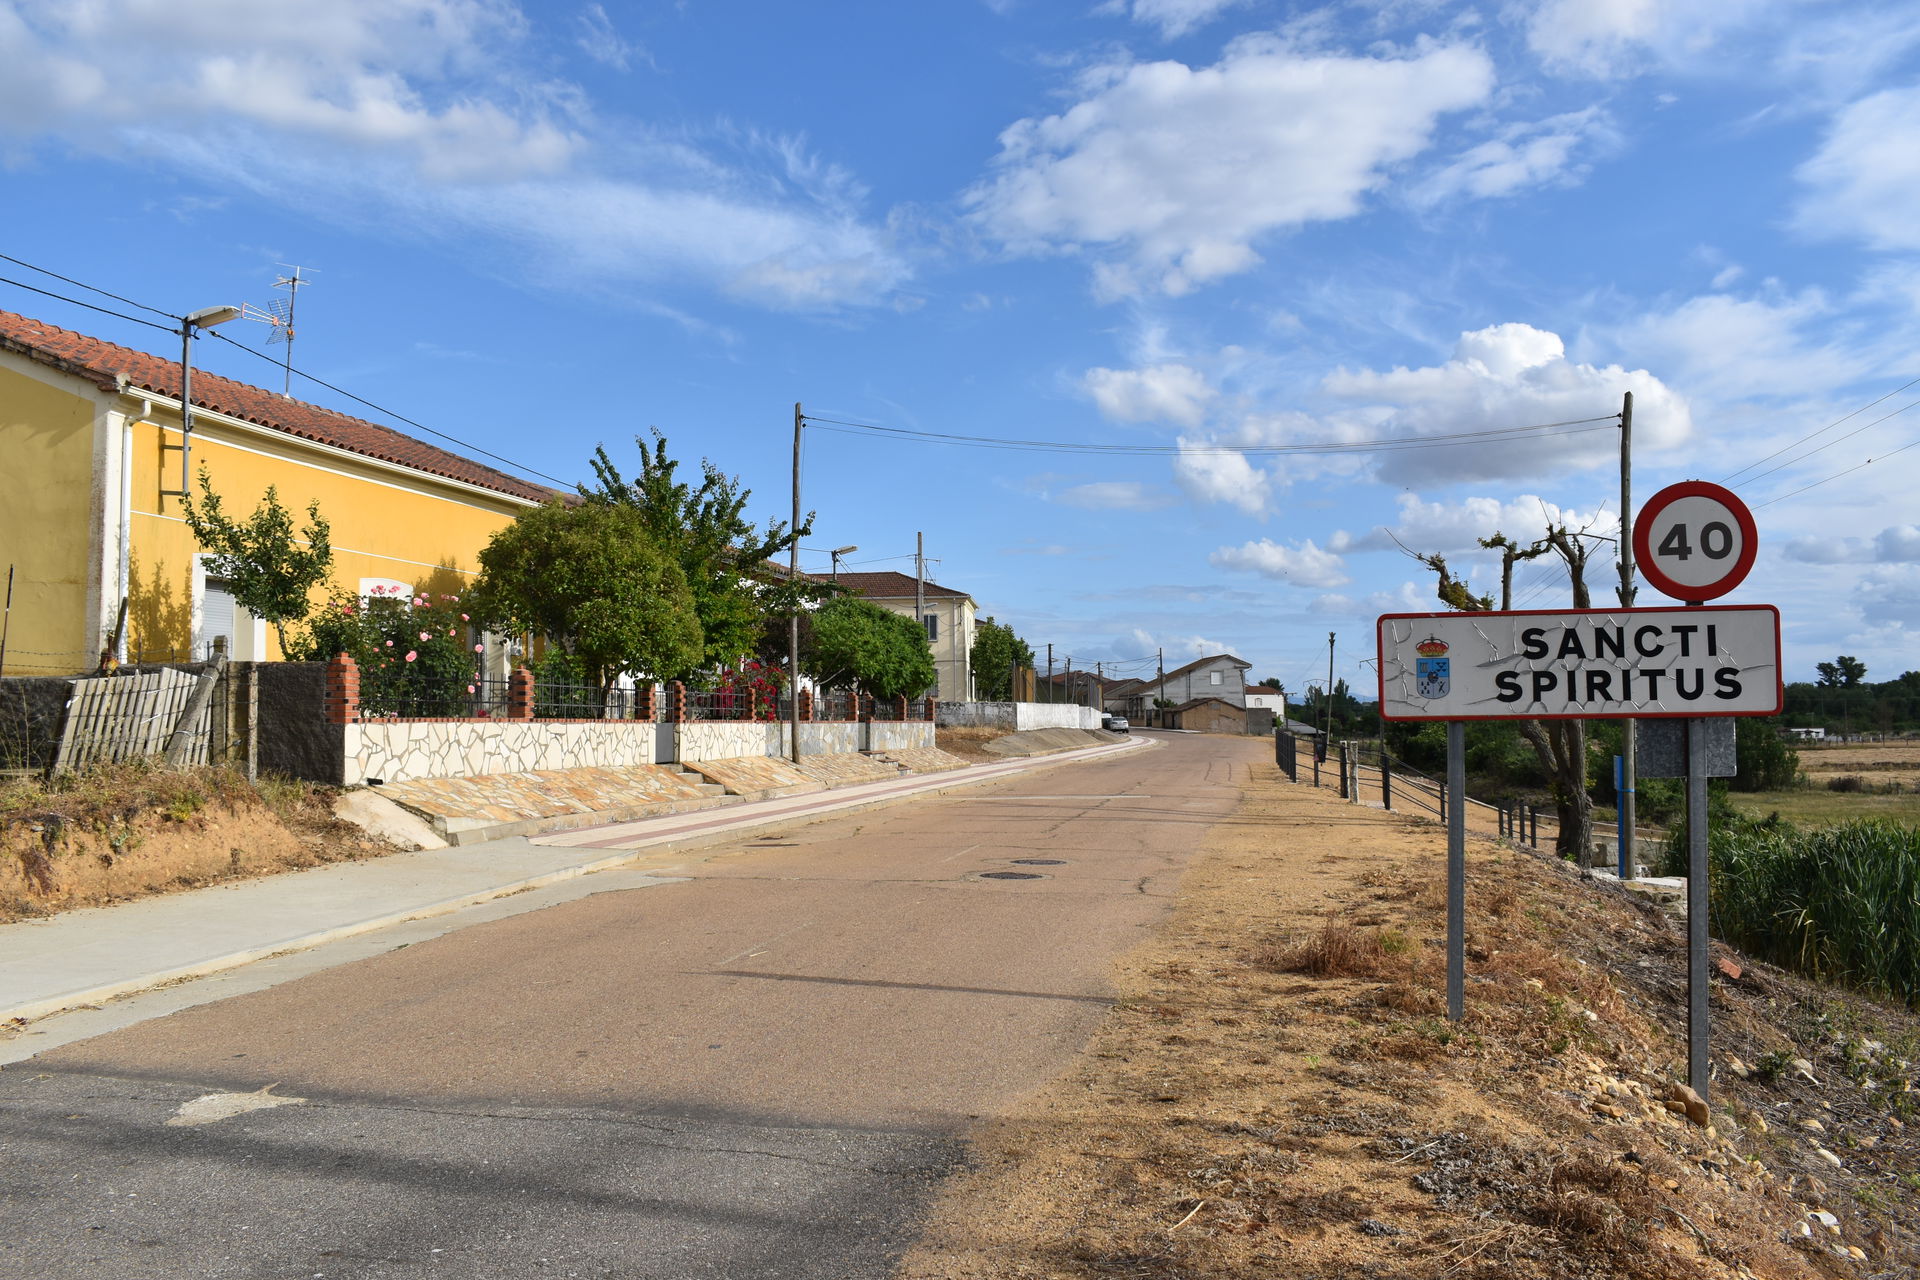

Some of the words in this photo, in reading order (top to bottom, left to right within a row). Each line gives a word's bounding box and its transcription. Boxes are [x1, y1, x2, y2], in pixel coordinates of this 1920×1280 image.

[1657, 521, 1734, 561] 40
[1521, 624, 1717, 660] SANCTI
[1495, 667, 1743, 702] SPIRITUS
